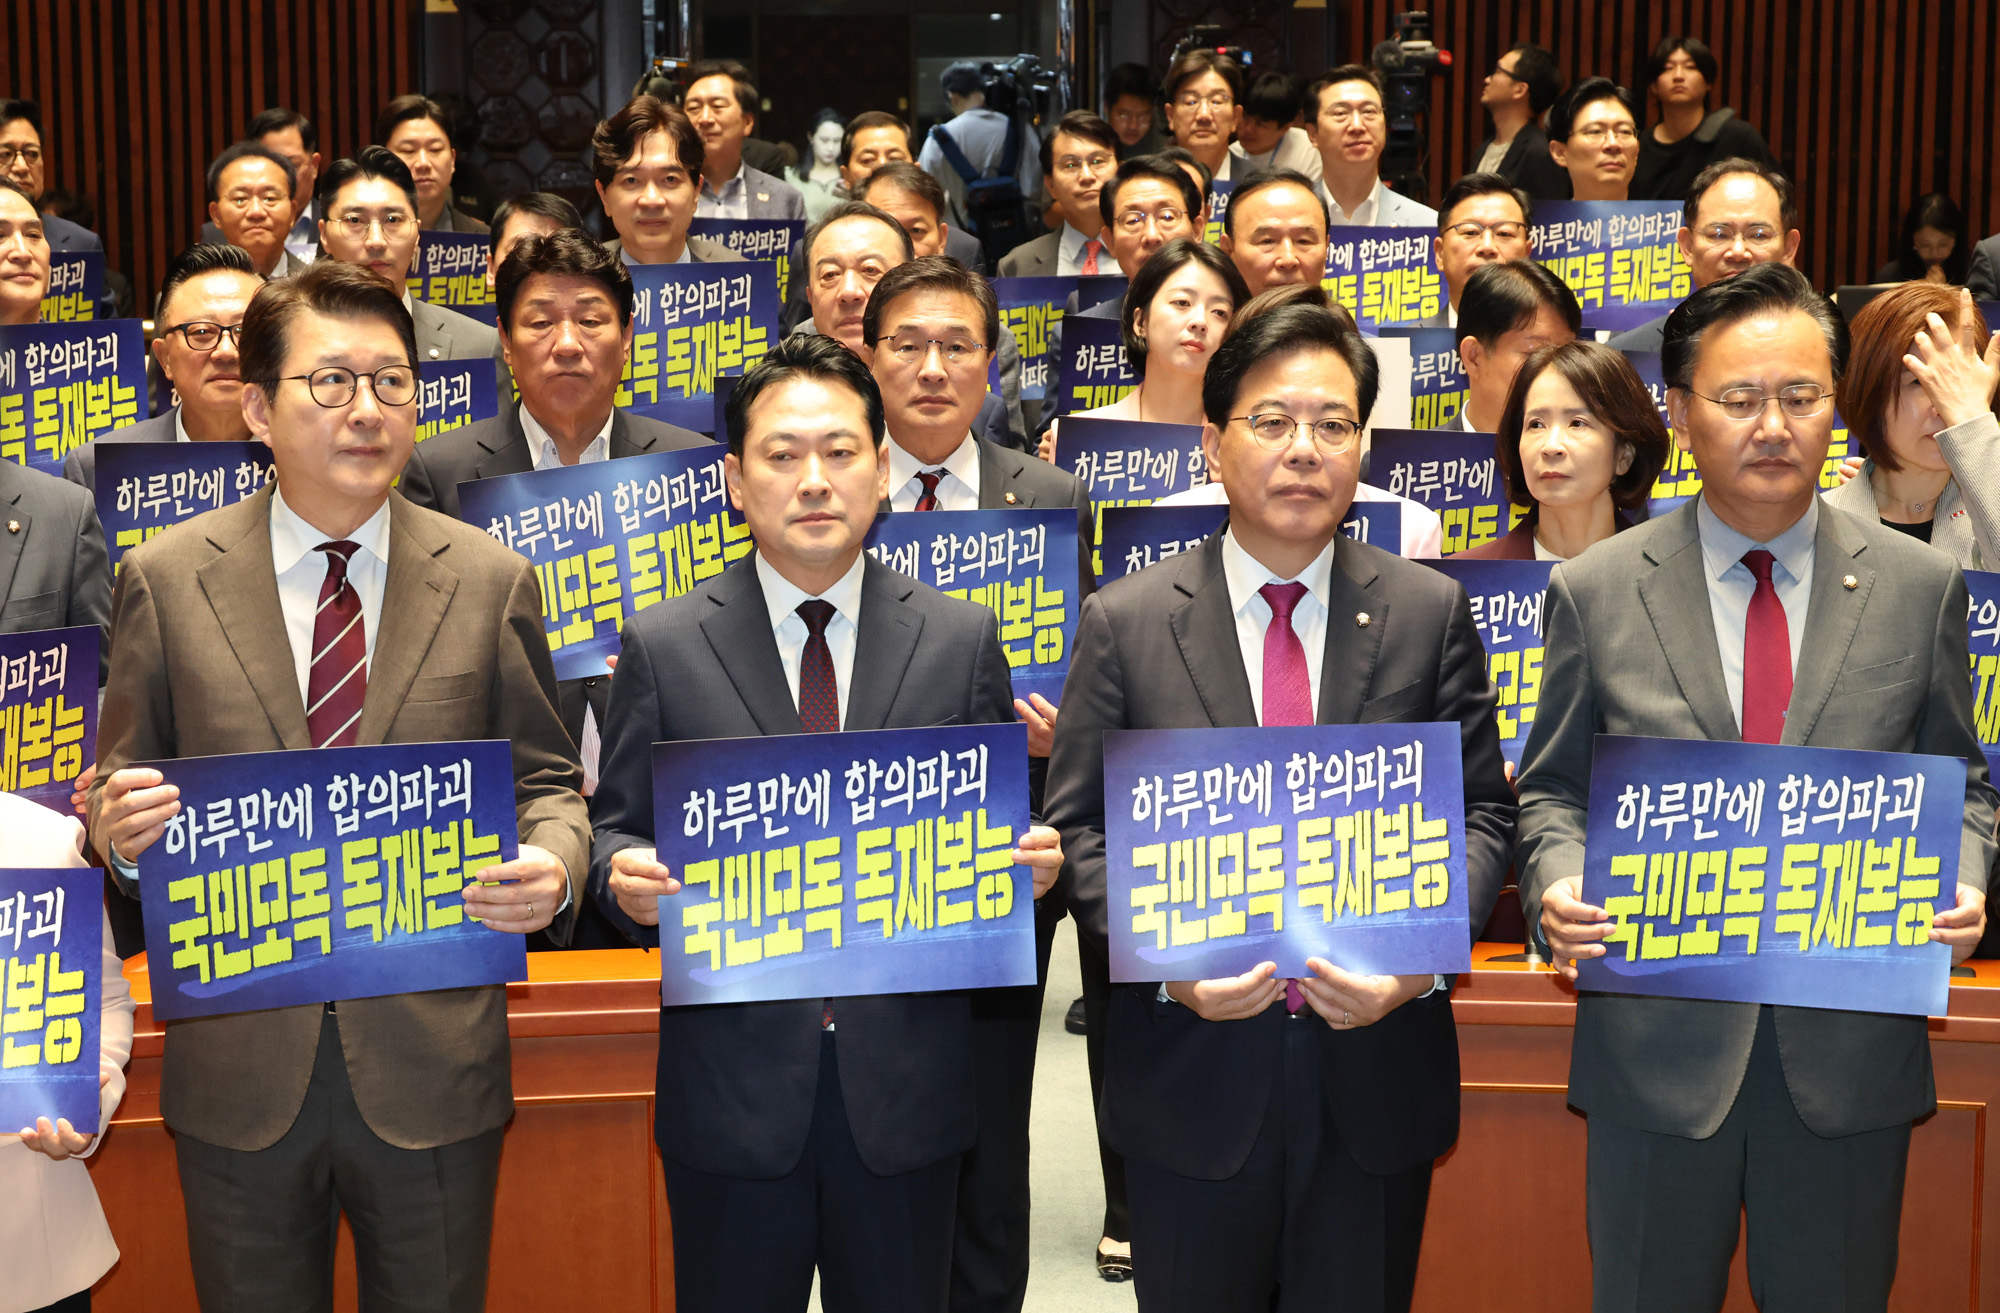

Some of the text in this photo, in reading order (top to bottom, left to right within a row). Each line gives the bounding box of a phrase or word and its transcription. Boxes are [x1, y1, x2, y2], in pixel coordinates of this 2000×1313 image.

[728, 227, 790, 257] 합의파괴
[1359, 235, 1430, 271] 합의파괴
[1529, 210, 1682, 256] 하루만에 합의파괴
[659, 273, 752, 326] 합의파괴
[1362, 265, 1441, 325] 독재본능
[1610, 242, 1692, 305] 독재본능
[25, 332, 119, 387] 합의파괴
[33, 374, 138, 461] 독재본능
[116, 466, 225, 520] 하루만에
[1074, 447, 1179, 493] 하루만에
[1389, 457, 1496, 503] 하루만에
[487, 459, 729, 557] 하루만에 합의파괴
[931, 523, 1046, 586] 합의파괴
[0, 642, 68, 700] 파괴
[165, 758, 472, 864] 하루만에 합의파괴
[682, 743, 988, 848] 하루만에 합의파괴
[1131, 739, 1423, 832] 하루만에 합의파괴
[1615, 773, 1925, 842] 하루만에 합의파괴
[168, 818, 502, 984] 국민모독 독재본능
[682, 807, 1015, 971] 국민모독 독재본능
[1130, 801, 1450, 951] 국민모독 독재본능
[1602, 836, 1941, 962] 국민모독 독재본능
[0, 951, 85, 1069] 본능
